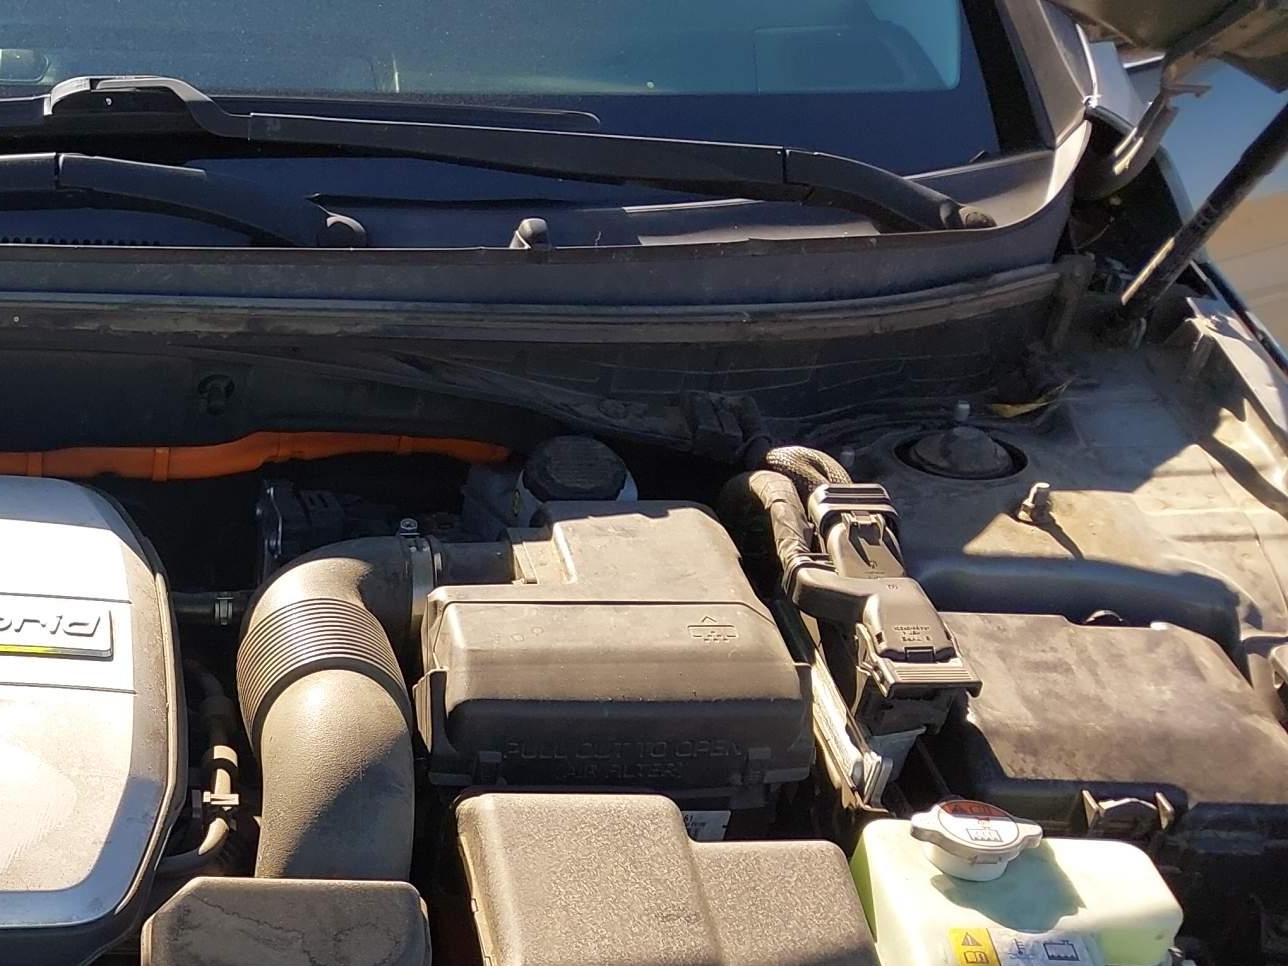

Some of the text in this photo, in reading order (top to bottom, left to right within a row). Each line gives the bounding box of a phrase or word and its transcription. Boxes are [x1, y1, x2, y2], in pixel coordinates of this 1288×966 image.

[503, 738, 744, 759] PULL OUT TO OPEN
